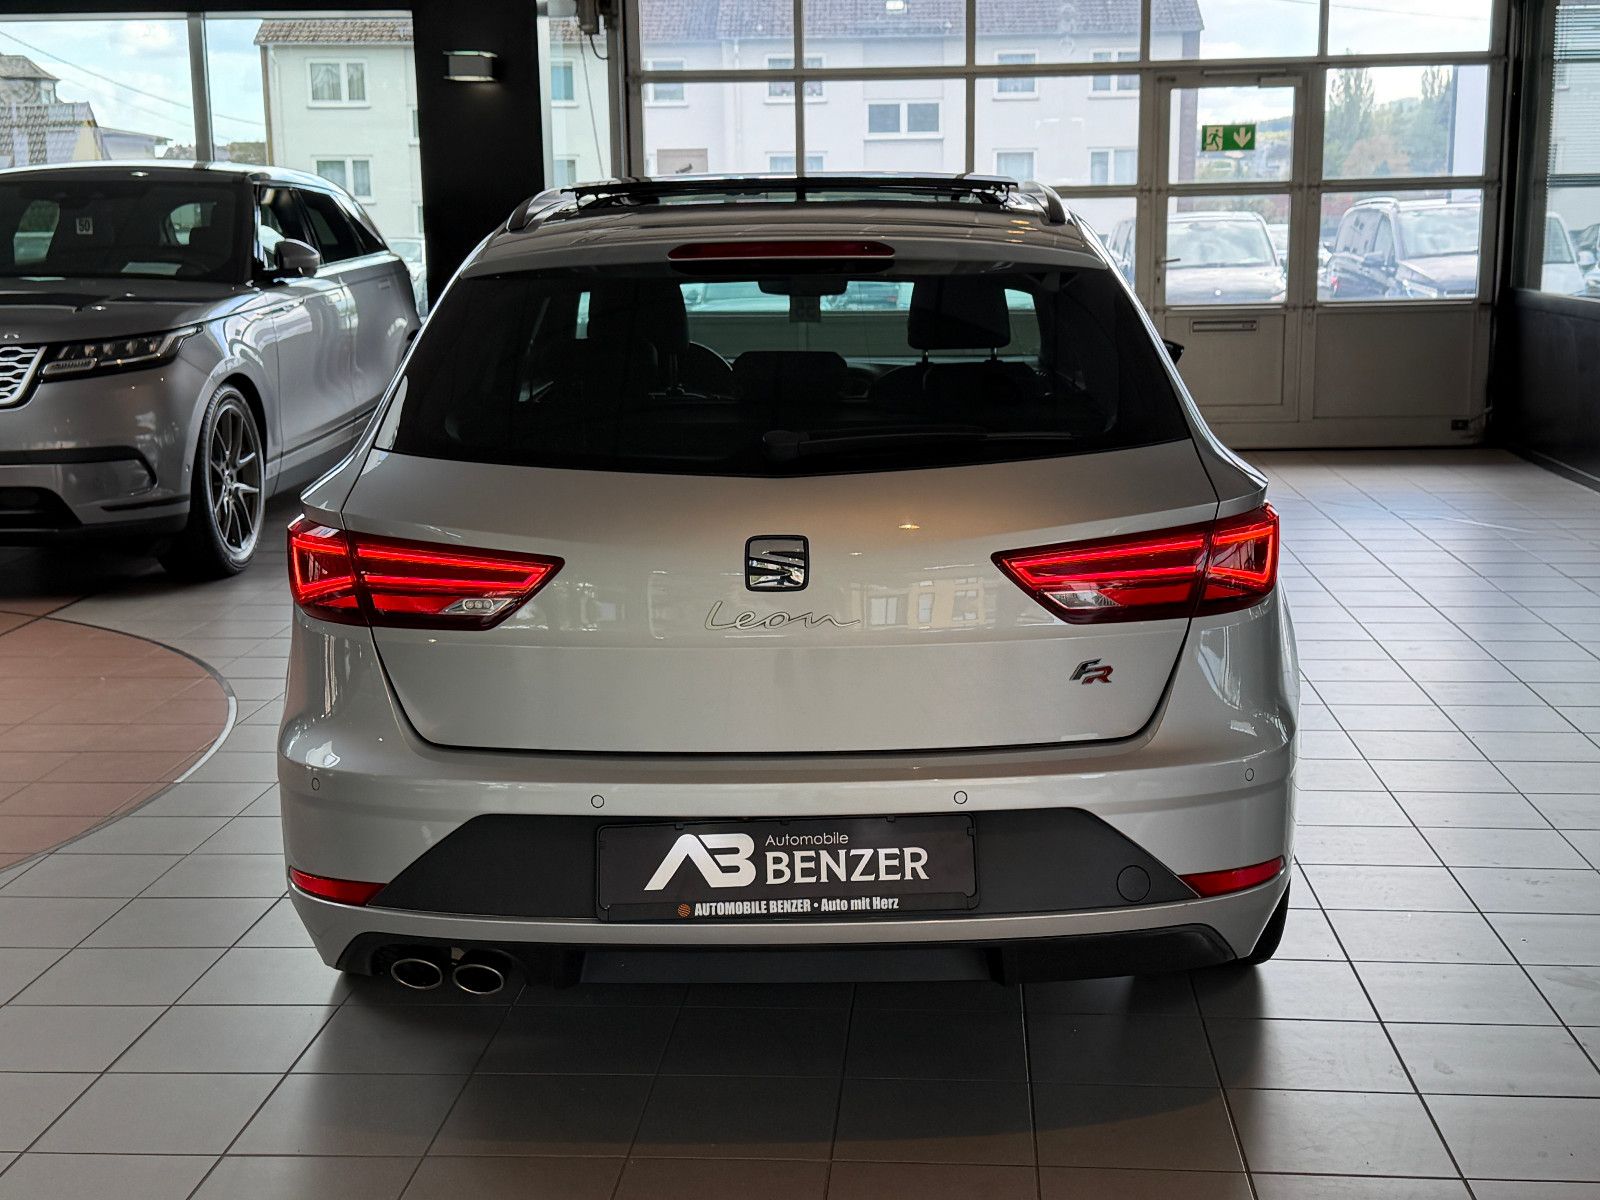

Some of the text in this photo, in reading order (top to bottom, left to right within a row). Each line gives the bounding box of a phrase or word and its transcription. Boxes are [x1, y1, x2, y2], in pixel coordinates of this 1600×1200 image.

[704, 600, 861, 630] Leon
[1069, 658, 1113, 684] FR
[765, 832, 849, 846] Automobile
[764, 847, 930, 885] BENZER
[694, 901, 768, 917] AUTOMOBILE
[769, 899, 811, 914] BENZER
[820, 898, 849, 912] Auto
[850, 897, 870, 911] mit
[872, 896, 900, 910] Herz
